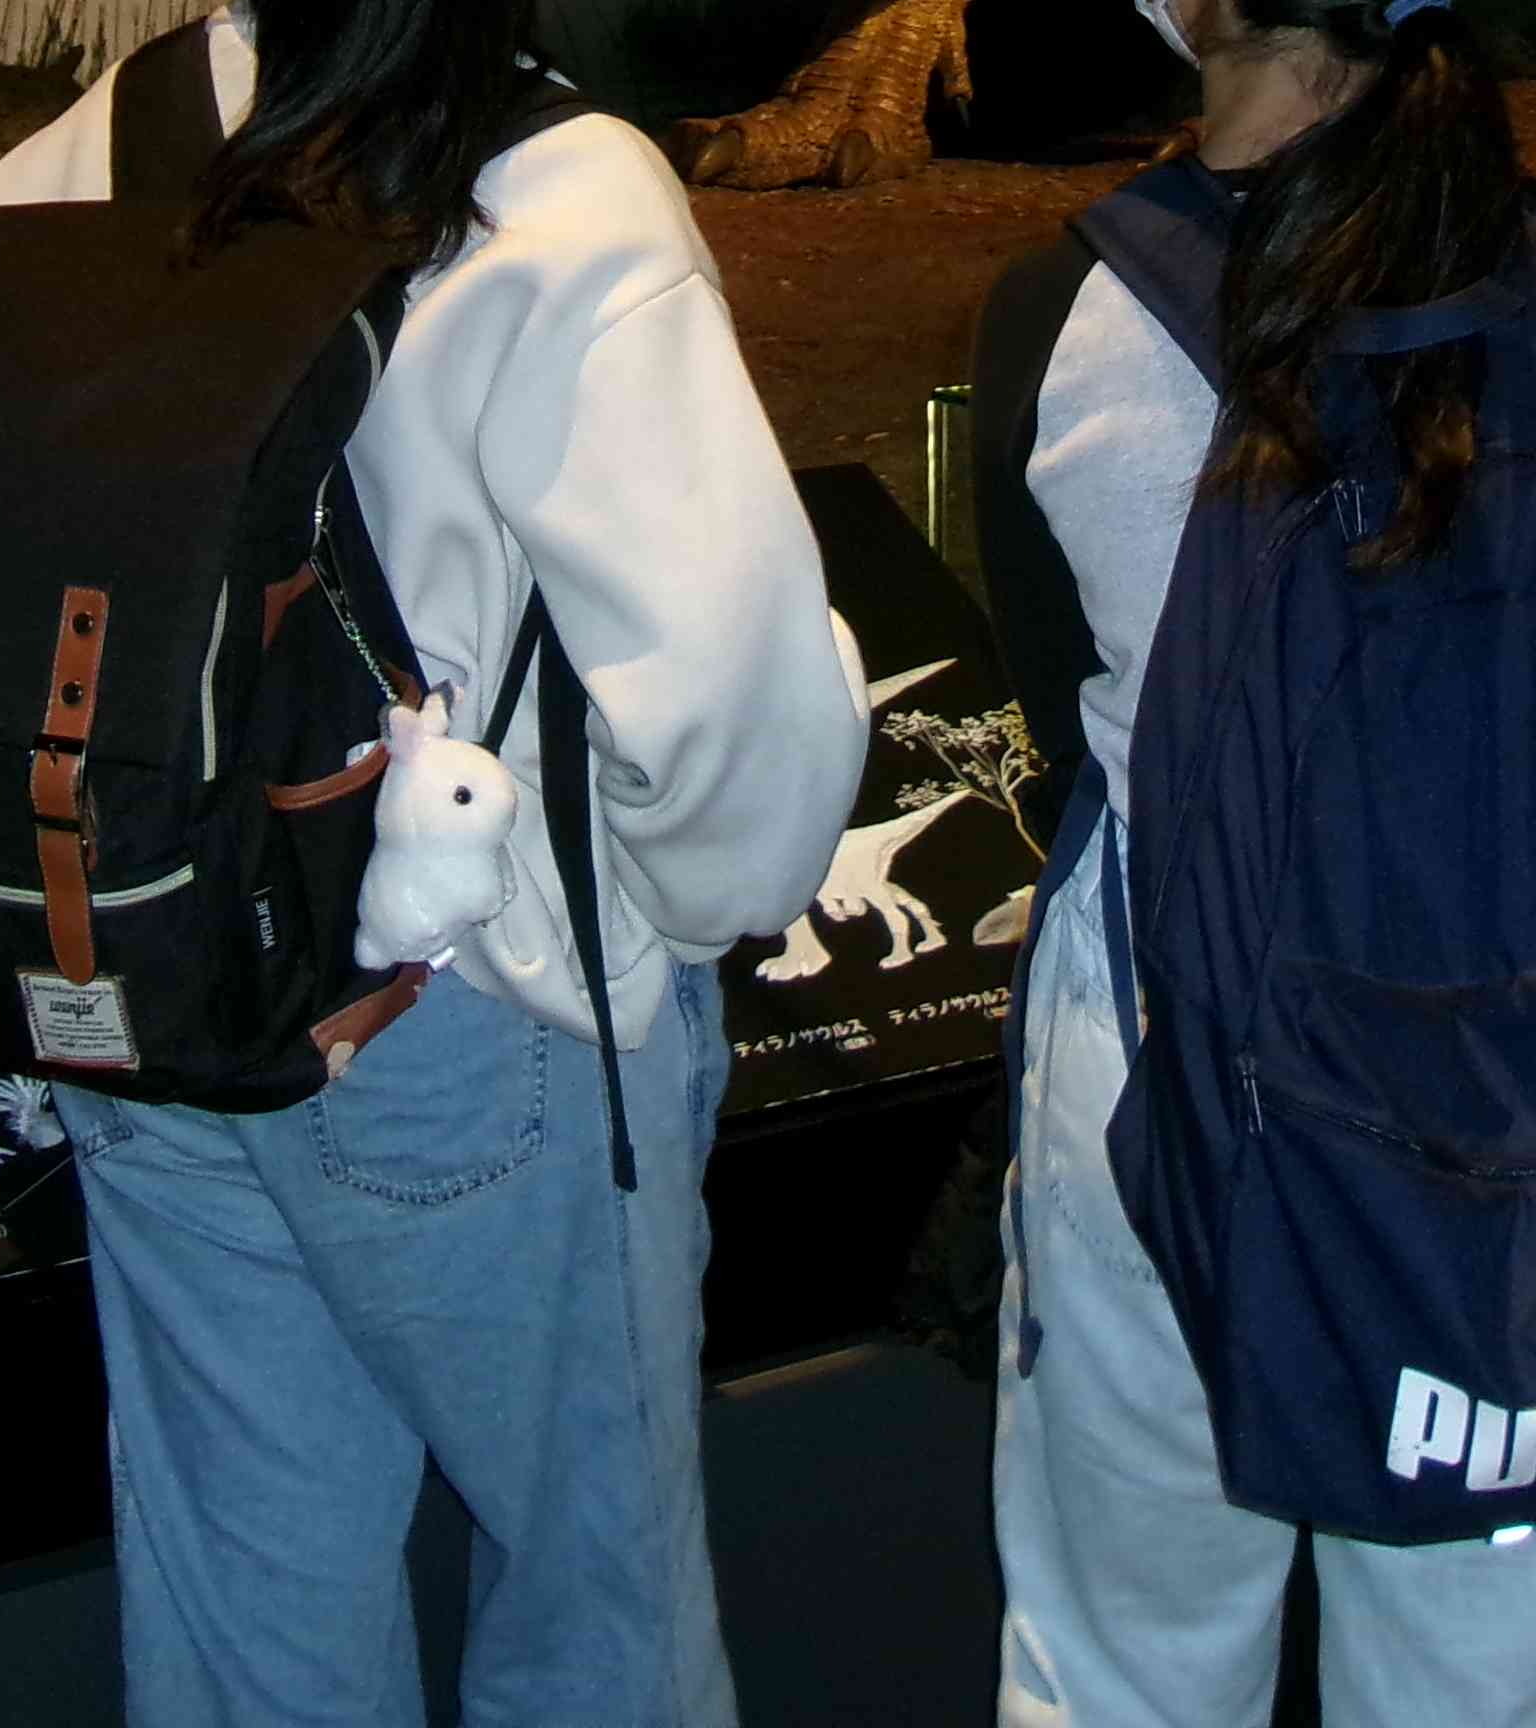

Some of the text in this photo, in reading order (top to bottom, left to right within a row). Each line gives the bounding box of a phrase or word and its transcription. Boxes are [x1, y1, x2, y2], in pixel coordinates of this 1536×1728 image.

[733, 1018, 868, 1058] ティラノサウルス
